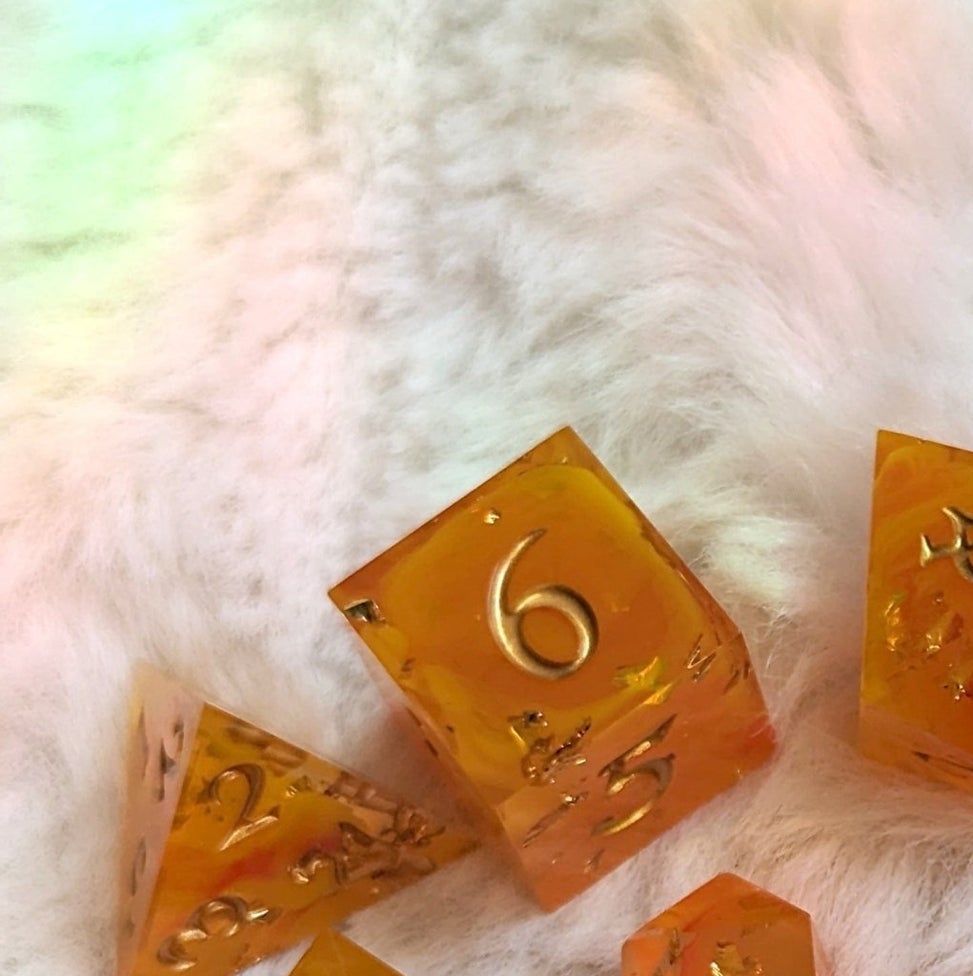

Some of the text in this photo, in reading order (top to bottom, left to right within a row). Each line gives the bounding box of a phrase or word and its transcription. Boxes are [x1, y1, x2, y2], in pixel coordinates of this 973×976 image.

[488, 528, 599, 681] 6
[202, 762, 281, 852] 2
[591, 713, 677, 837] 5
